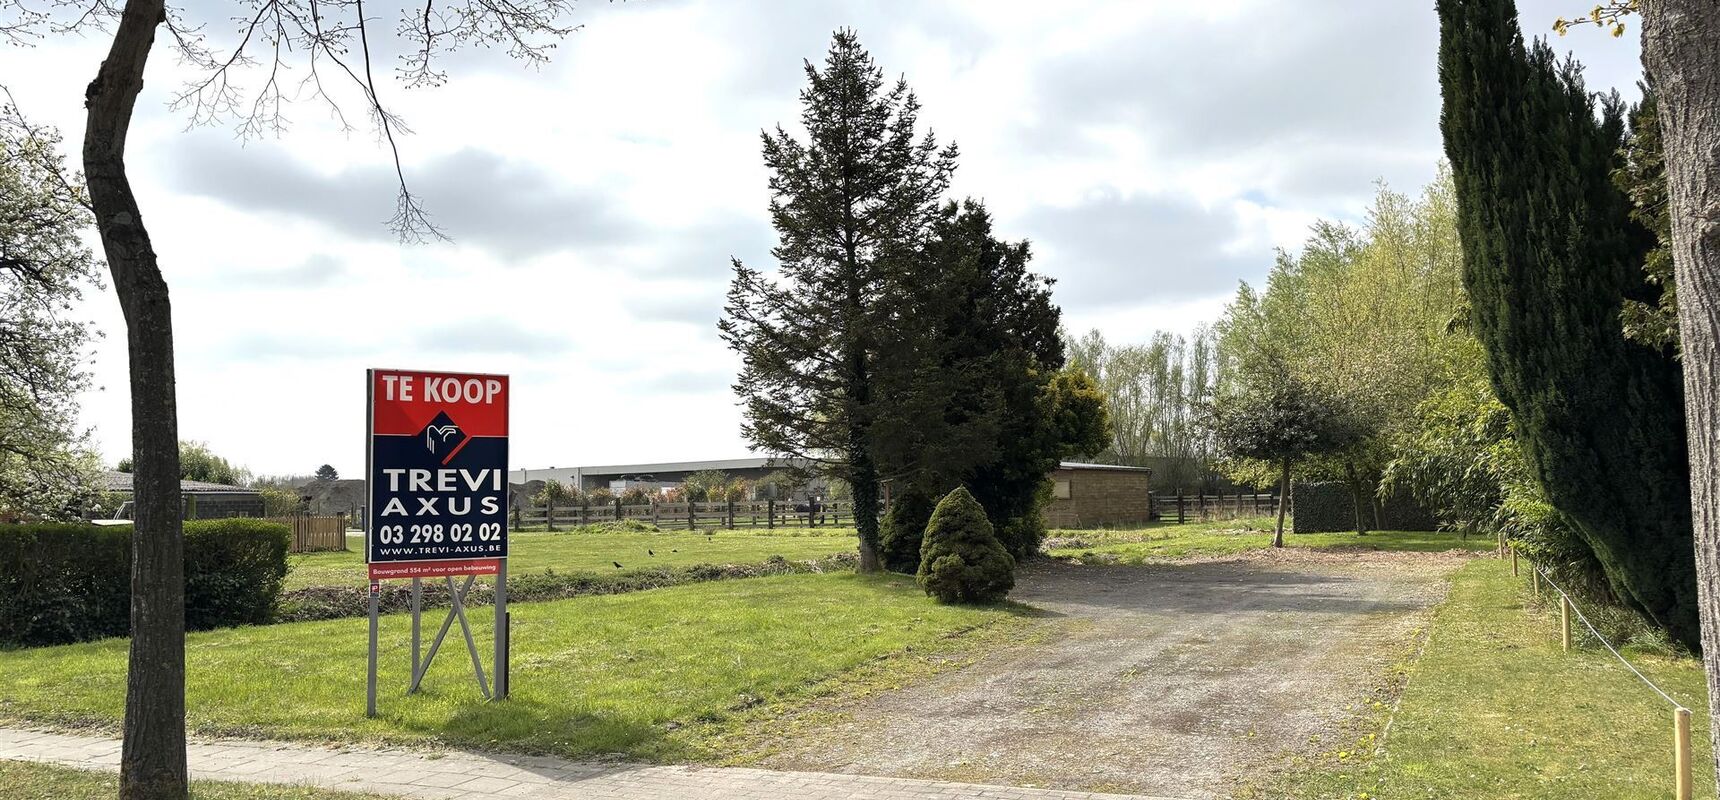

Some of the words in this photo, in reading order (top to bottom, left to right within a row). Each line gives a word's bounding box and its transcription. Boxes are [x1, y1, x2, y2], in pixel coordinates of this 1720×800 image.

[382, 375, 413, 401] TE
[424, 377, 502, 404] KOOP
[383, 469, 501, 492] TREVI
[381, 496, 499, 517] AXUS
[380, 525, 404, 545] 03
[410, 524, 444, 544] 298
[450, 523, 472, 543] 02
[479, 522, 501, 541] 02
[380, 544, 501, 556] WWW.TREVI-AXUS.BE
[372, 568, 409, 576] Bouwgrond
